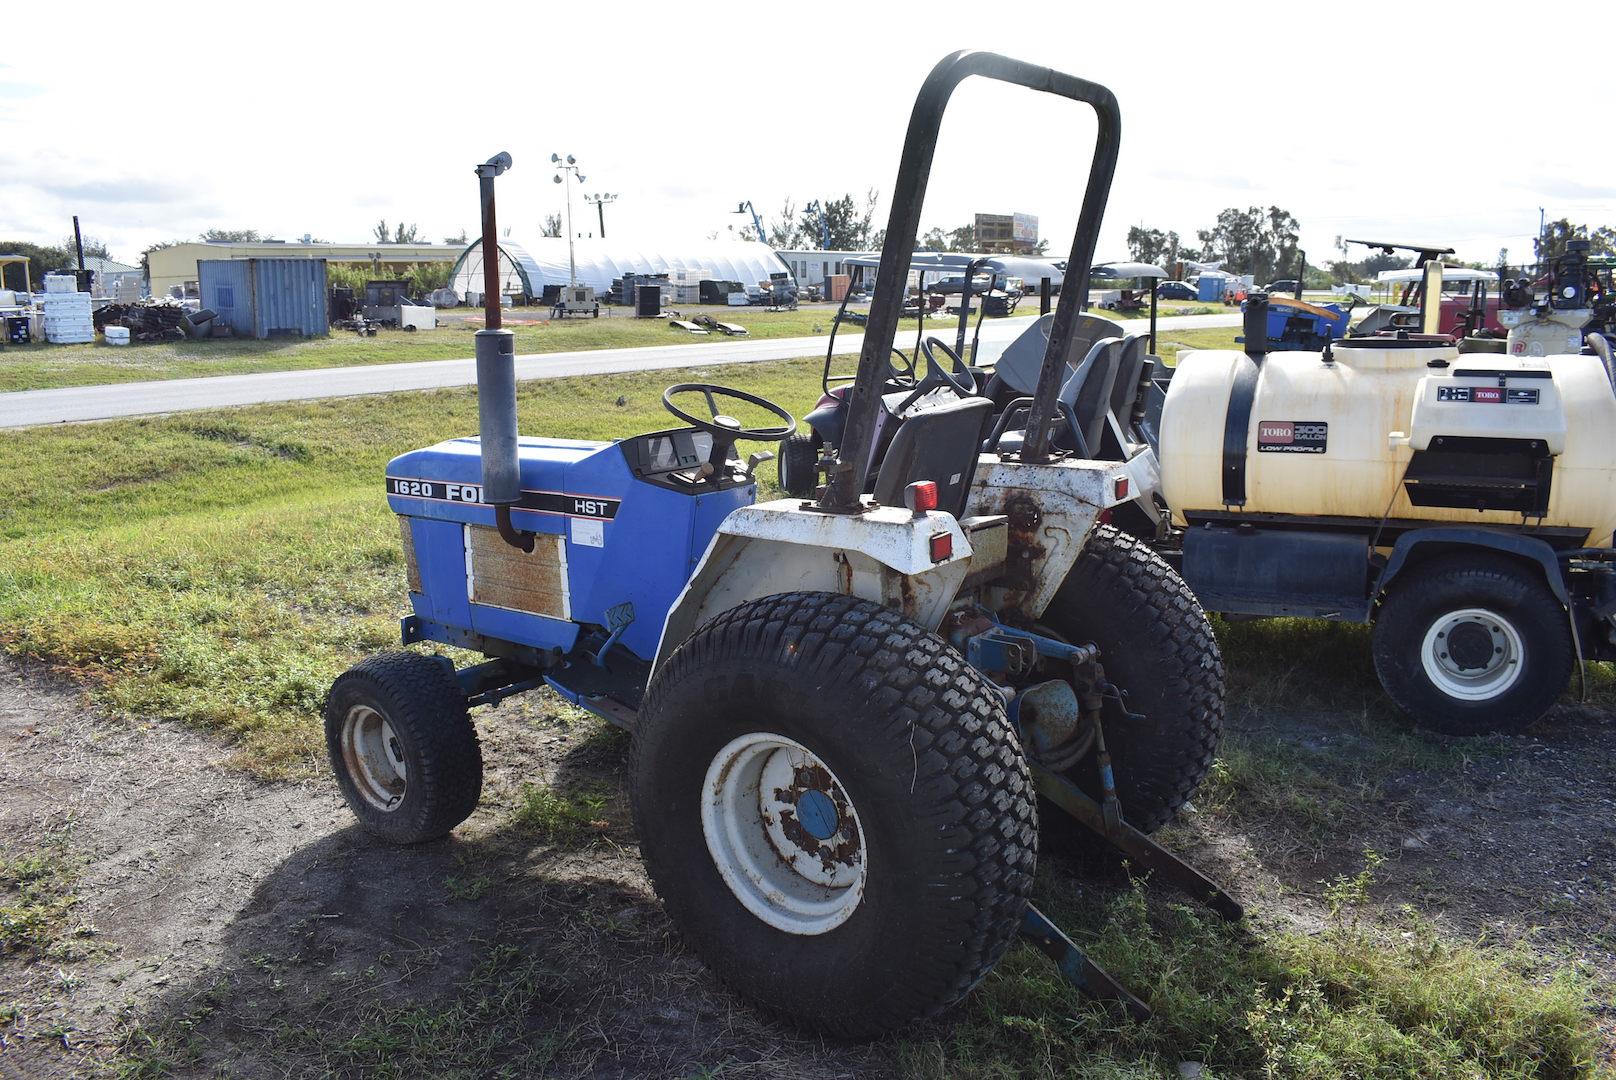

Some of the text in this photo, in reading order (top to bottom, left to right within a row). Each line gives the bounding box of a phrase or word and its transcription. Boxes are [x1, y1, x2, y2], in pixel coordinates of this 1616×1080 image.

[1262, 428, 1291, 437] TORO
[1294, 425, 1327, 434] 300
[394, 480, 433, 497] 1620
[574, 500, 608, 515] HST
